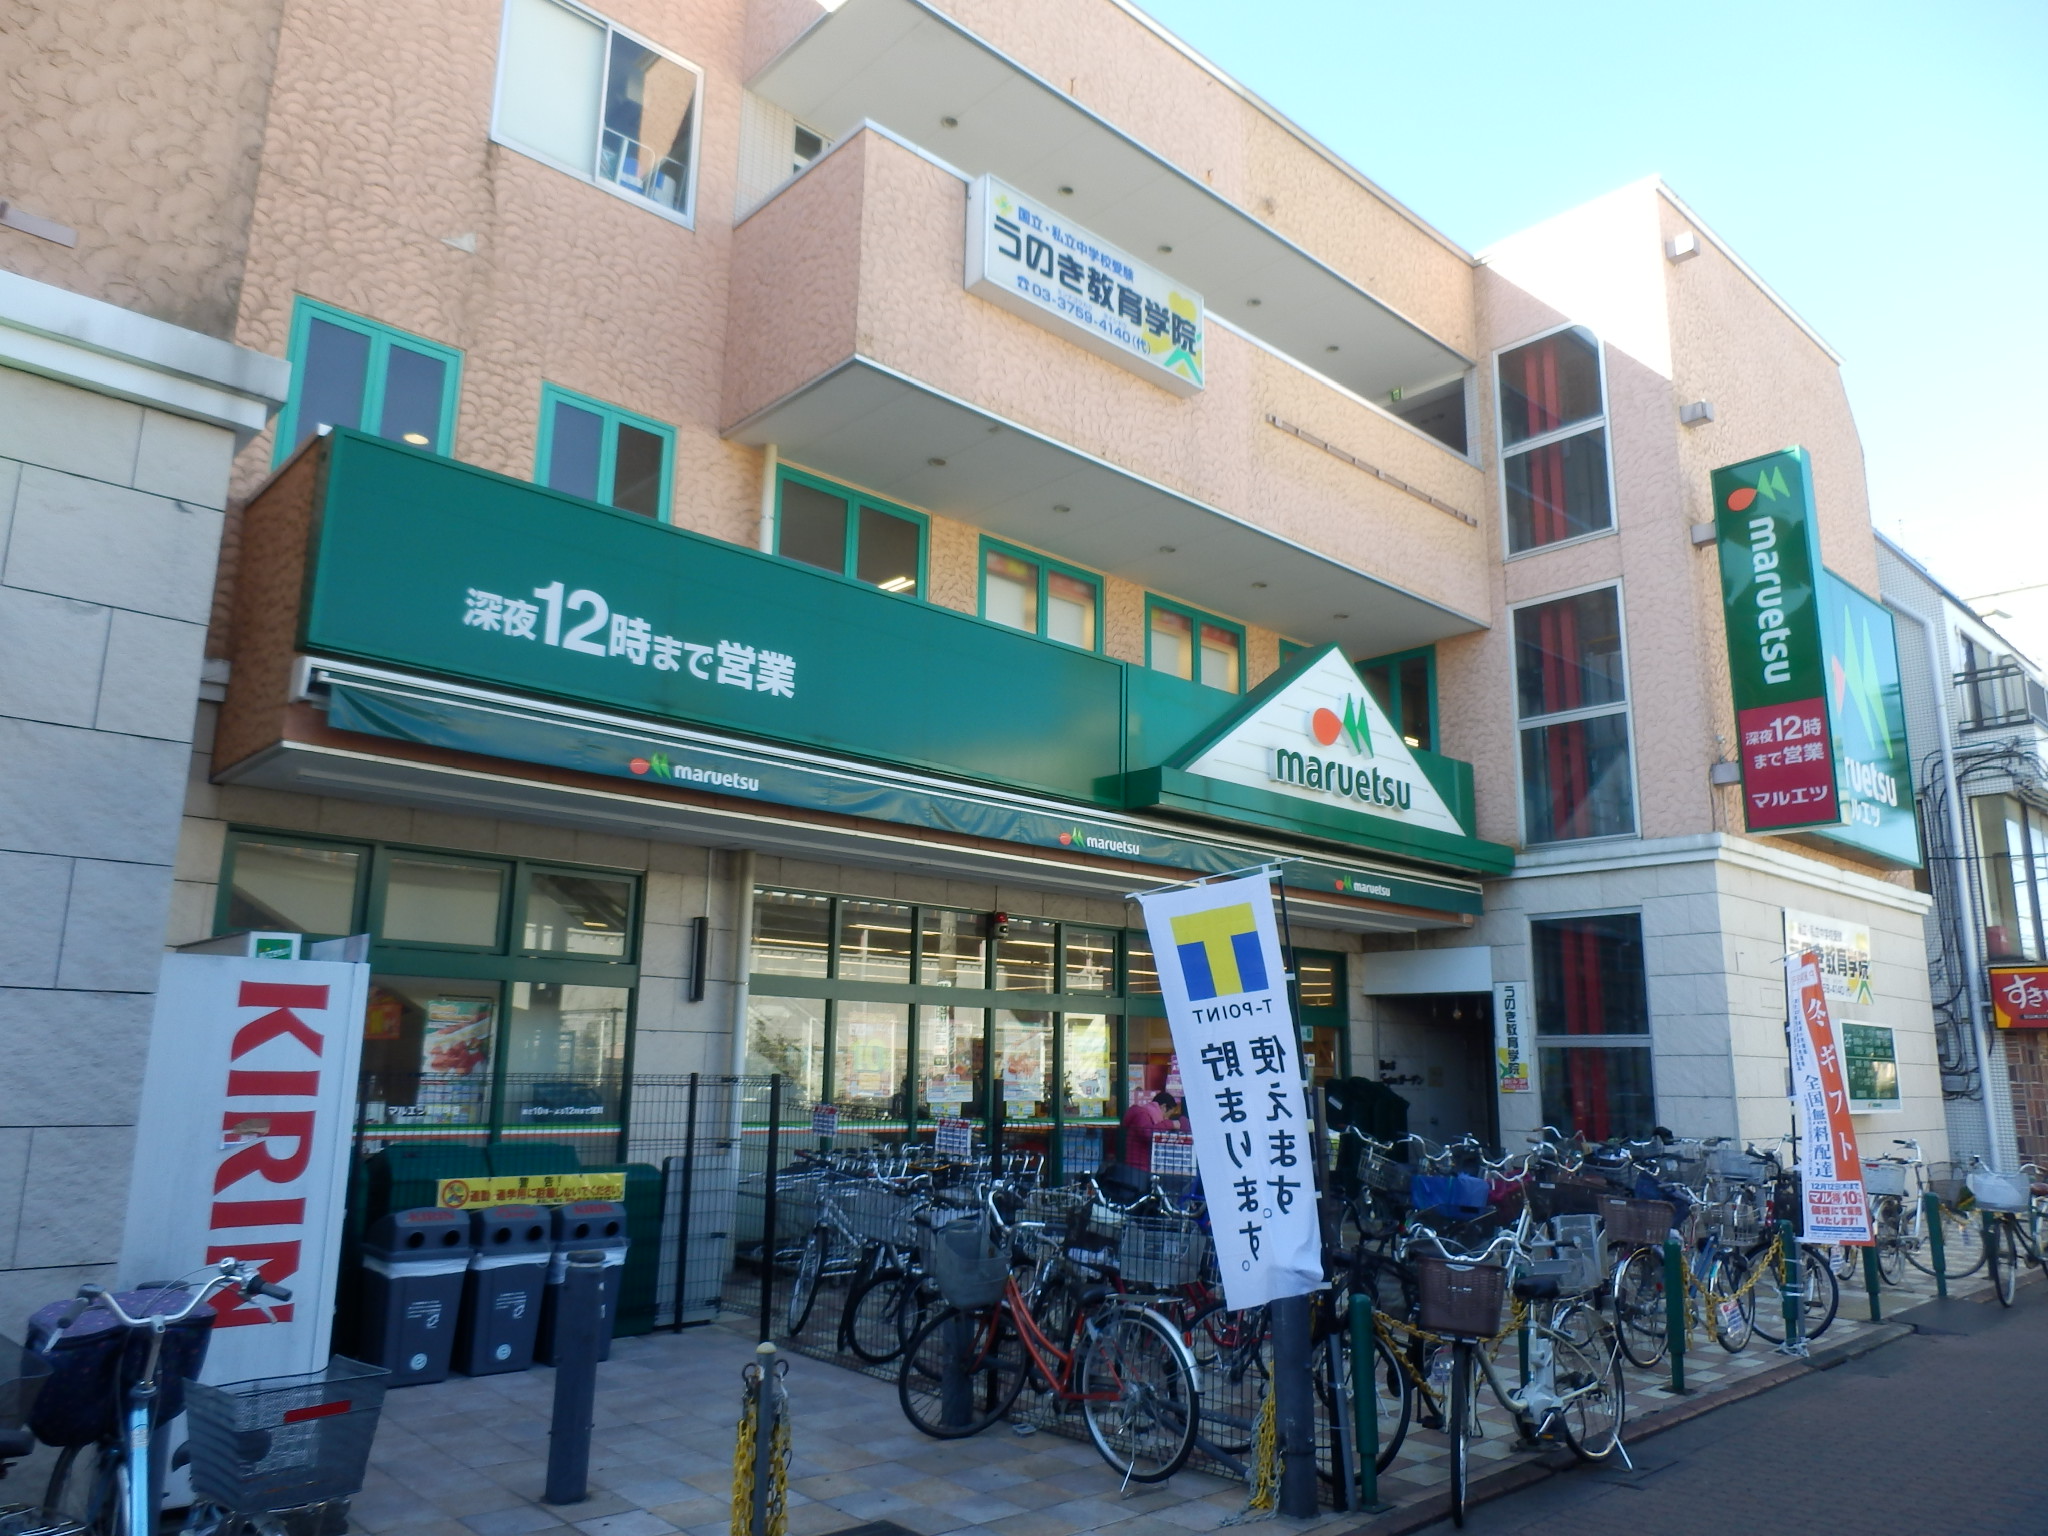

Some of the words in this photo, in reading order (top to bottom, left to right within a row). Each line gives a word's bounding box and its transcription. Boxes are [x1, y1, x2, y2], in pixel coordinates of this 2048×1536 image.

[994, 214, 1196, 355] うのき教育学院
[1749, 516, 1792, 685] maruetsu
[461, 580, 797, 699] 深夜12時まで営業
[1745, 716, 1822, 746] 深夜12時
[1754, 742, 1825, 769] まで営業
[674, 765, 759, 793] maruetsu
[1275, 748, 1411, 811] maruetsu
[1751, 785, 1829, 809] マルエツ
[1844, 756, 1897, 807] ruetsu
[1850, 797, 1880, 827] ルエツ
[1086, 836, 1140, 856] maruetsu
[1353, 881, 1391, 897] maruetsu
[2002, 974, 2048, 1010] すき
[1504, 985, 1520, 1075] うのき教育学院
[1807, 997, 1853, 1162] 冬ギフト
[1804, 1074, 1834, 1179] 全国無料配達
[207, 980, 330, 1329] KIRIN
